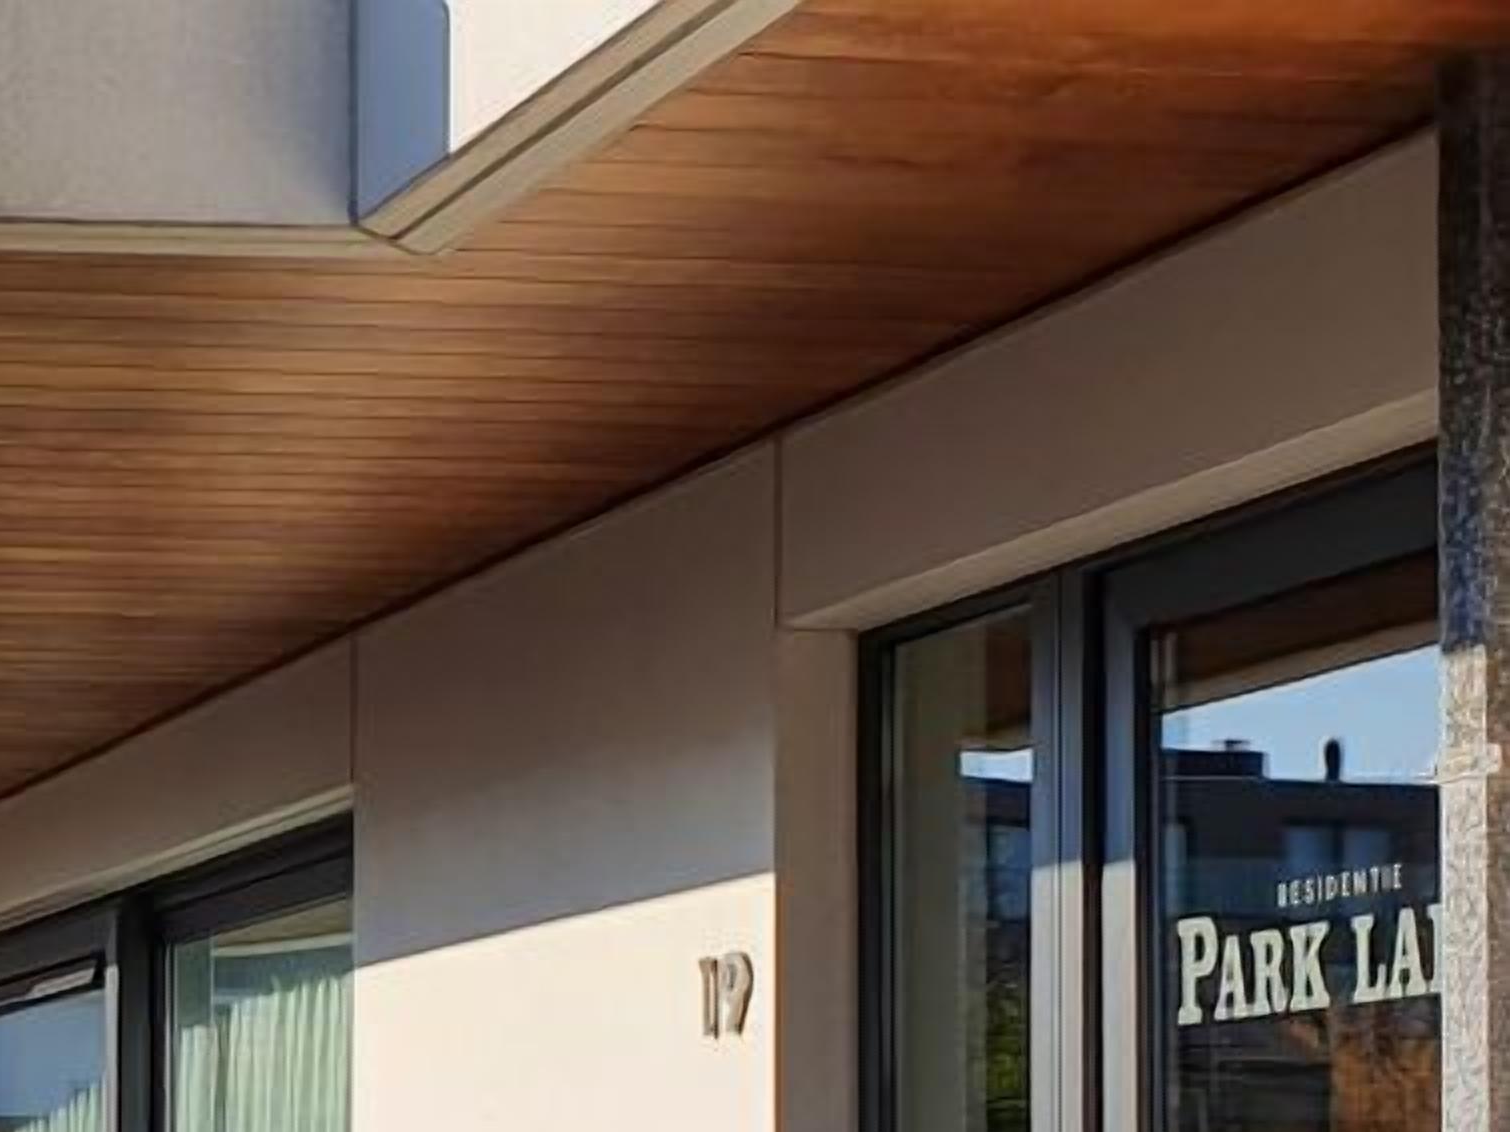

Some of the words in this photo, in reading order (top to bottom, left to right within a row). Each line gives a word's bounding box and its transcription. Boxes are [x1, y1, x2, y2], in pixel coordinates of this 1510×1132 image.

[1277, 863, 1402, 907] RESIDENTIE
[698, 951, 754, 1039] 19
[1177, 916, 1330, 1025] PARK
